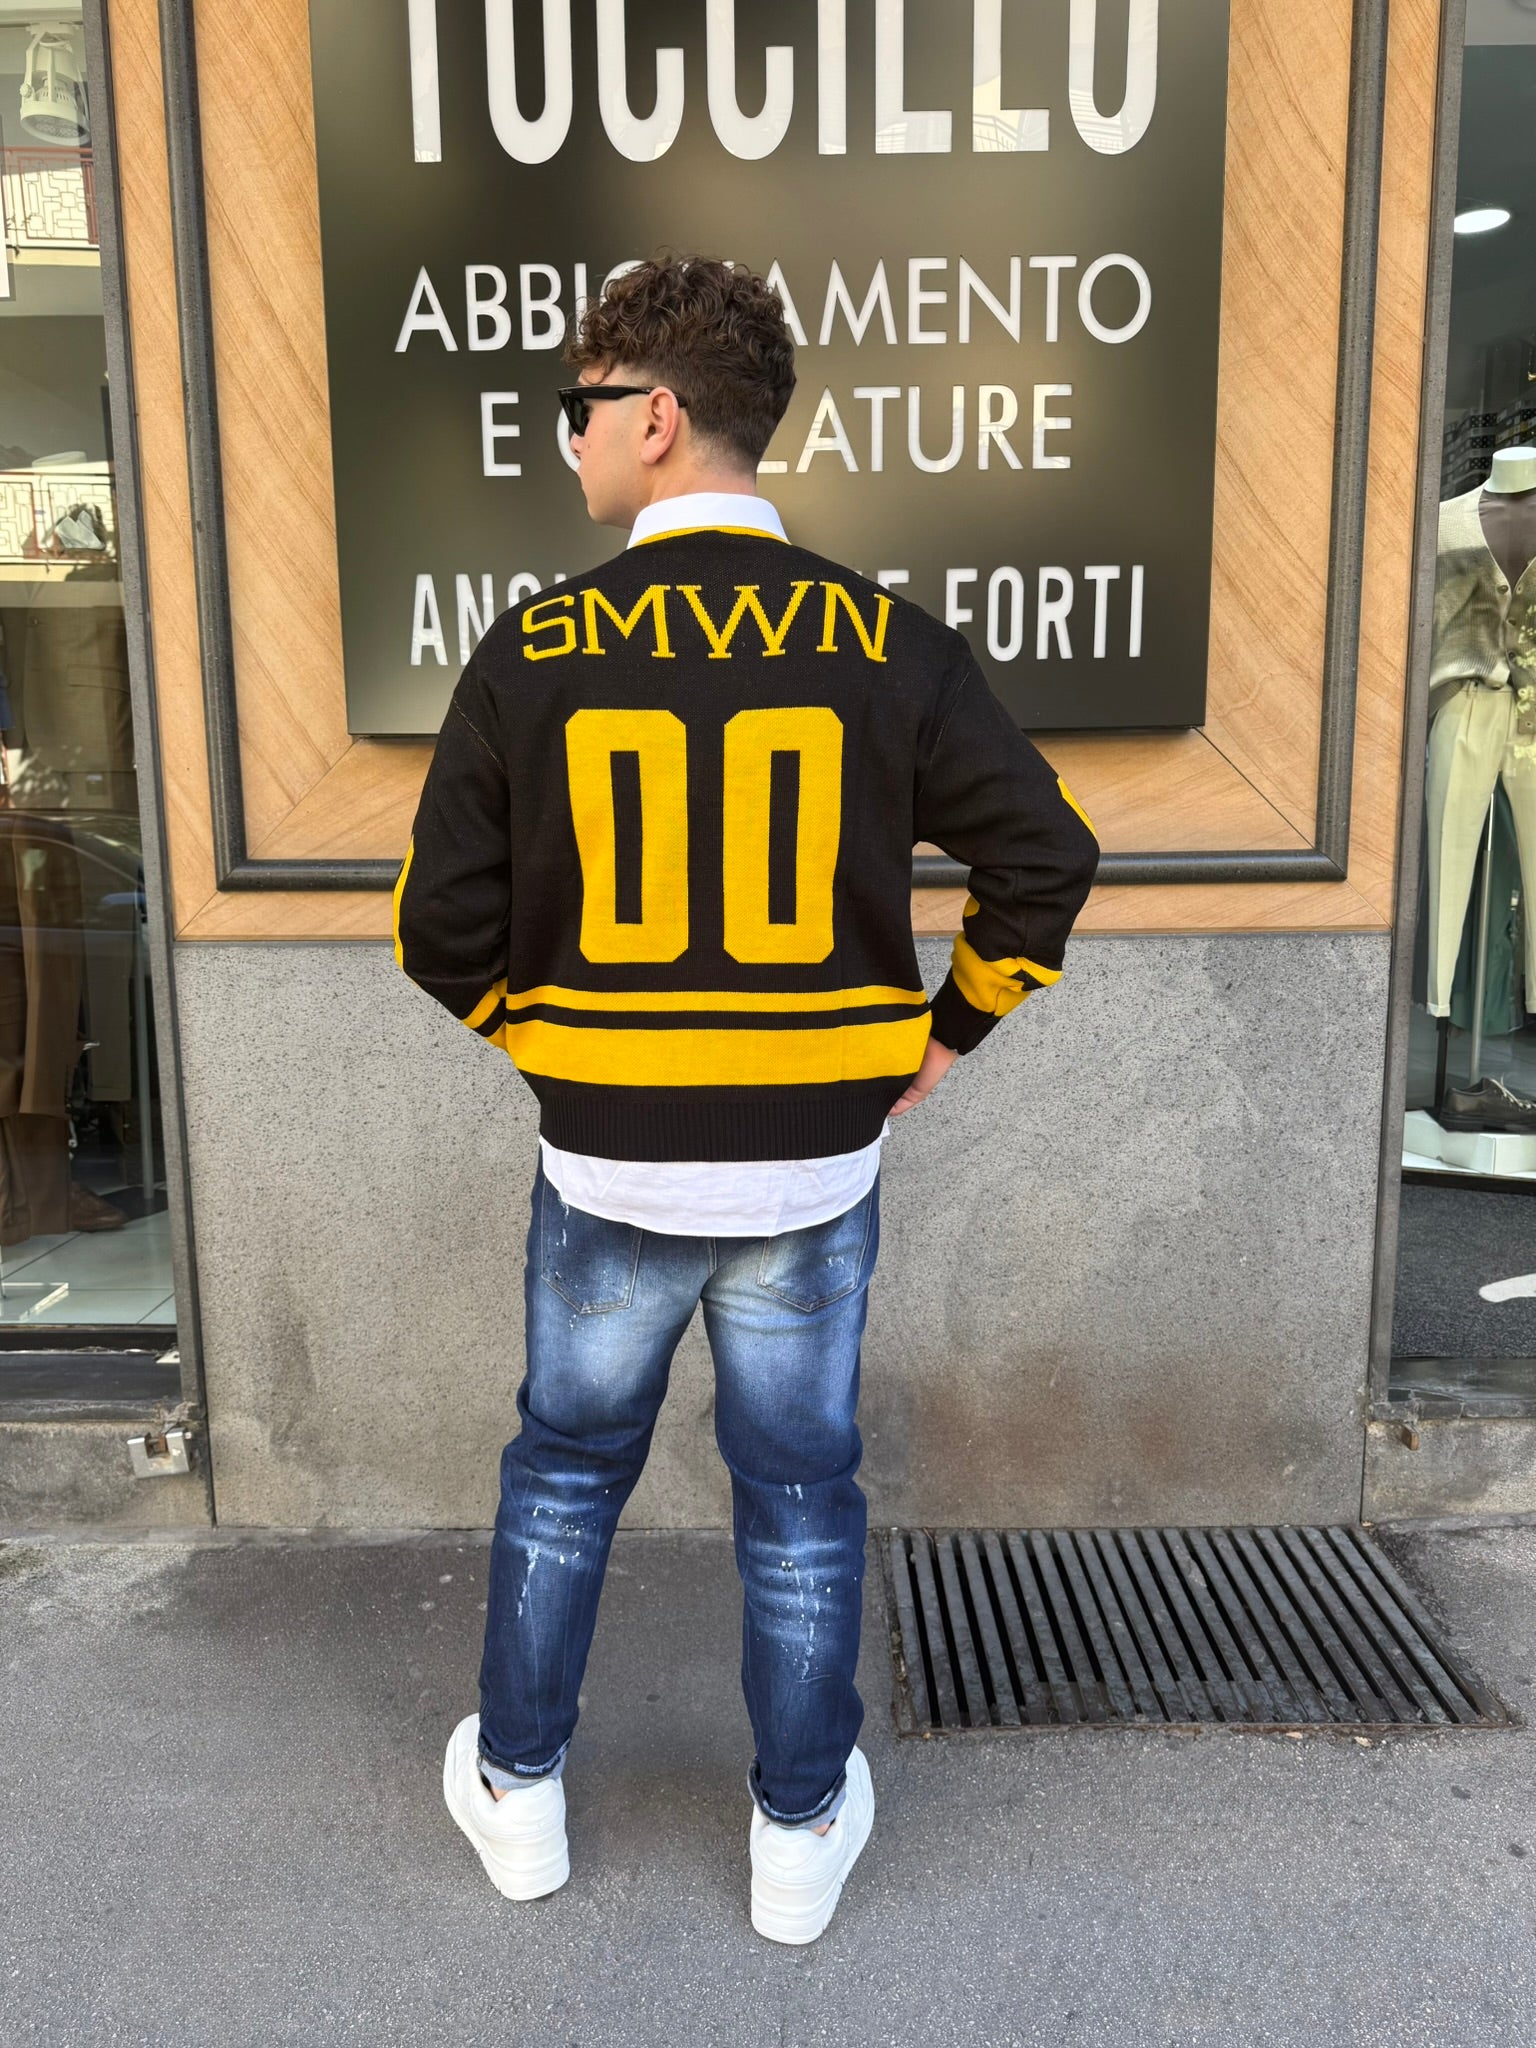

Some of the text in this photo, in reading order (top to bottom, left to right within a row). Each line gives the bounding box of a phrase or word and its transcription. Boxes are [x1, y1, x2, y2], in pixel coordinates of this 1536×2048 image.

[394, 253, 1152, 353] ABBIAMENTO
[480, 383, 1073, 477] E ATURE
[521, 580, 894, 663] SMWN
[945, 564, 1145, 663] FORTI
[565, 707, 844, 965] 00
